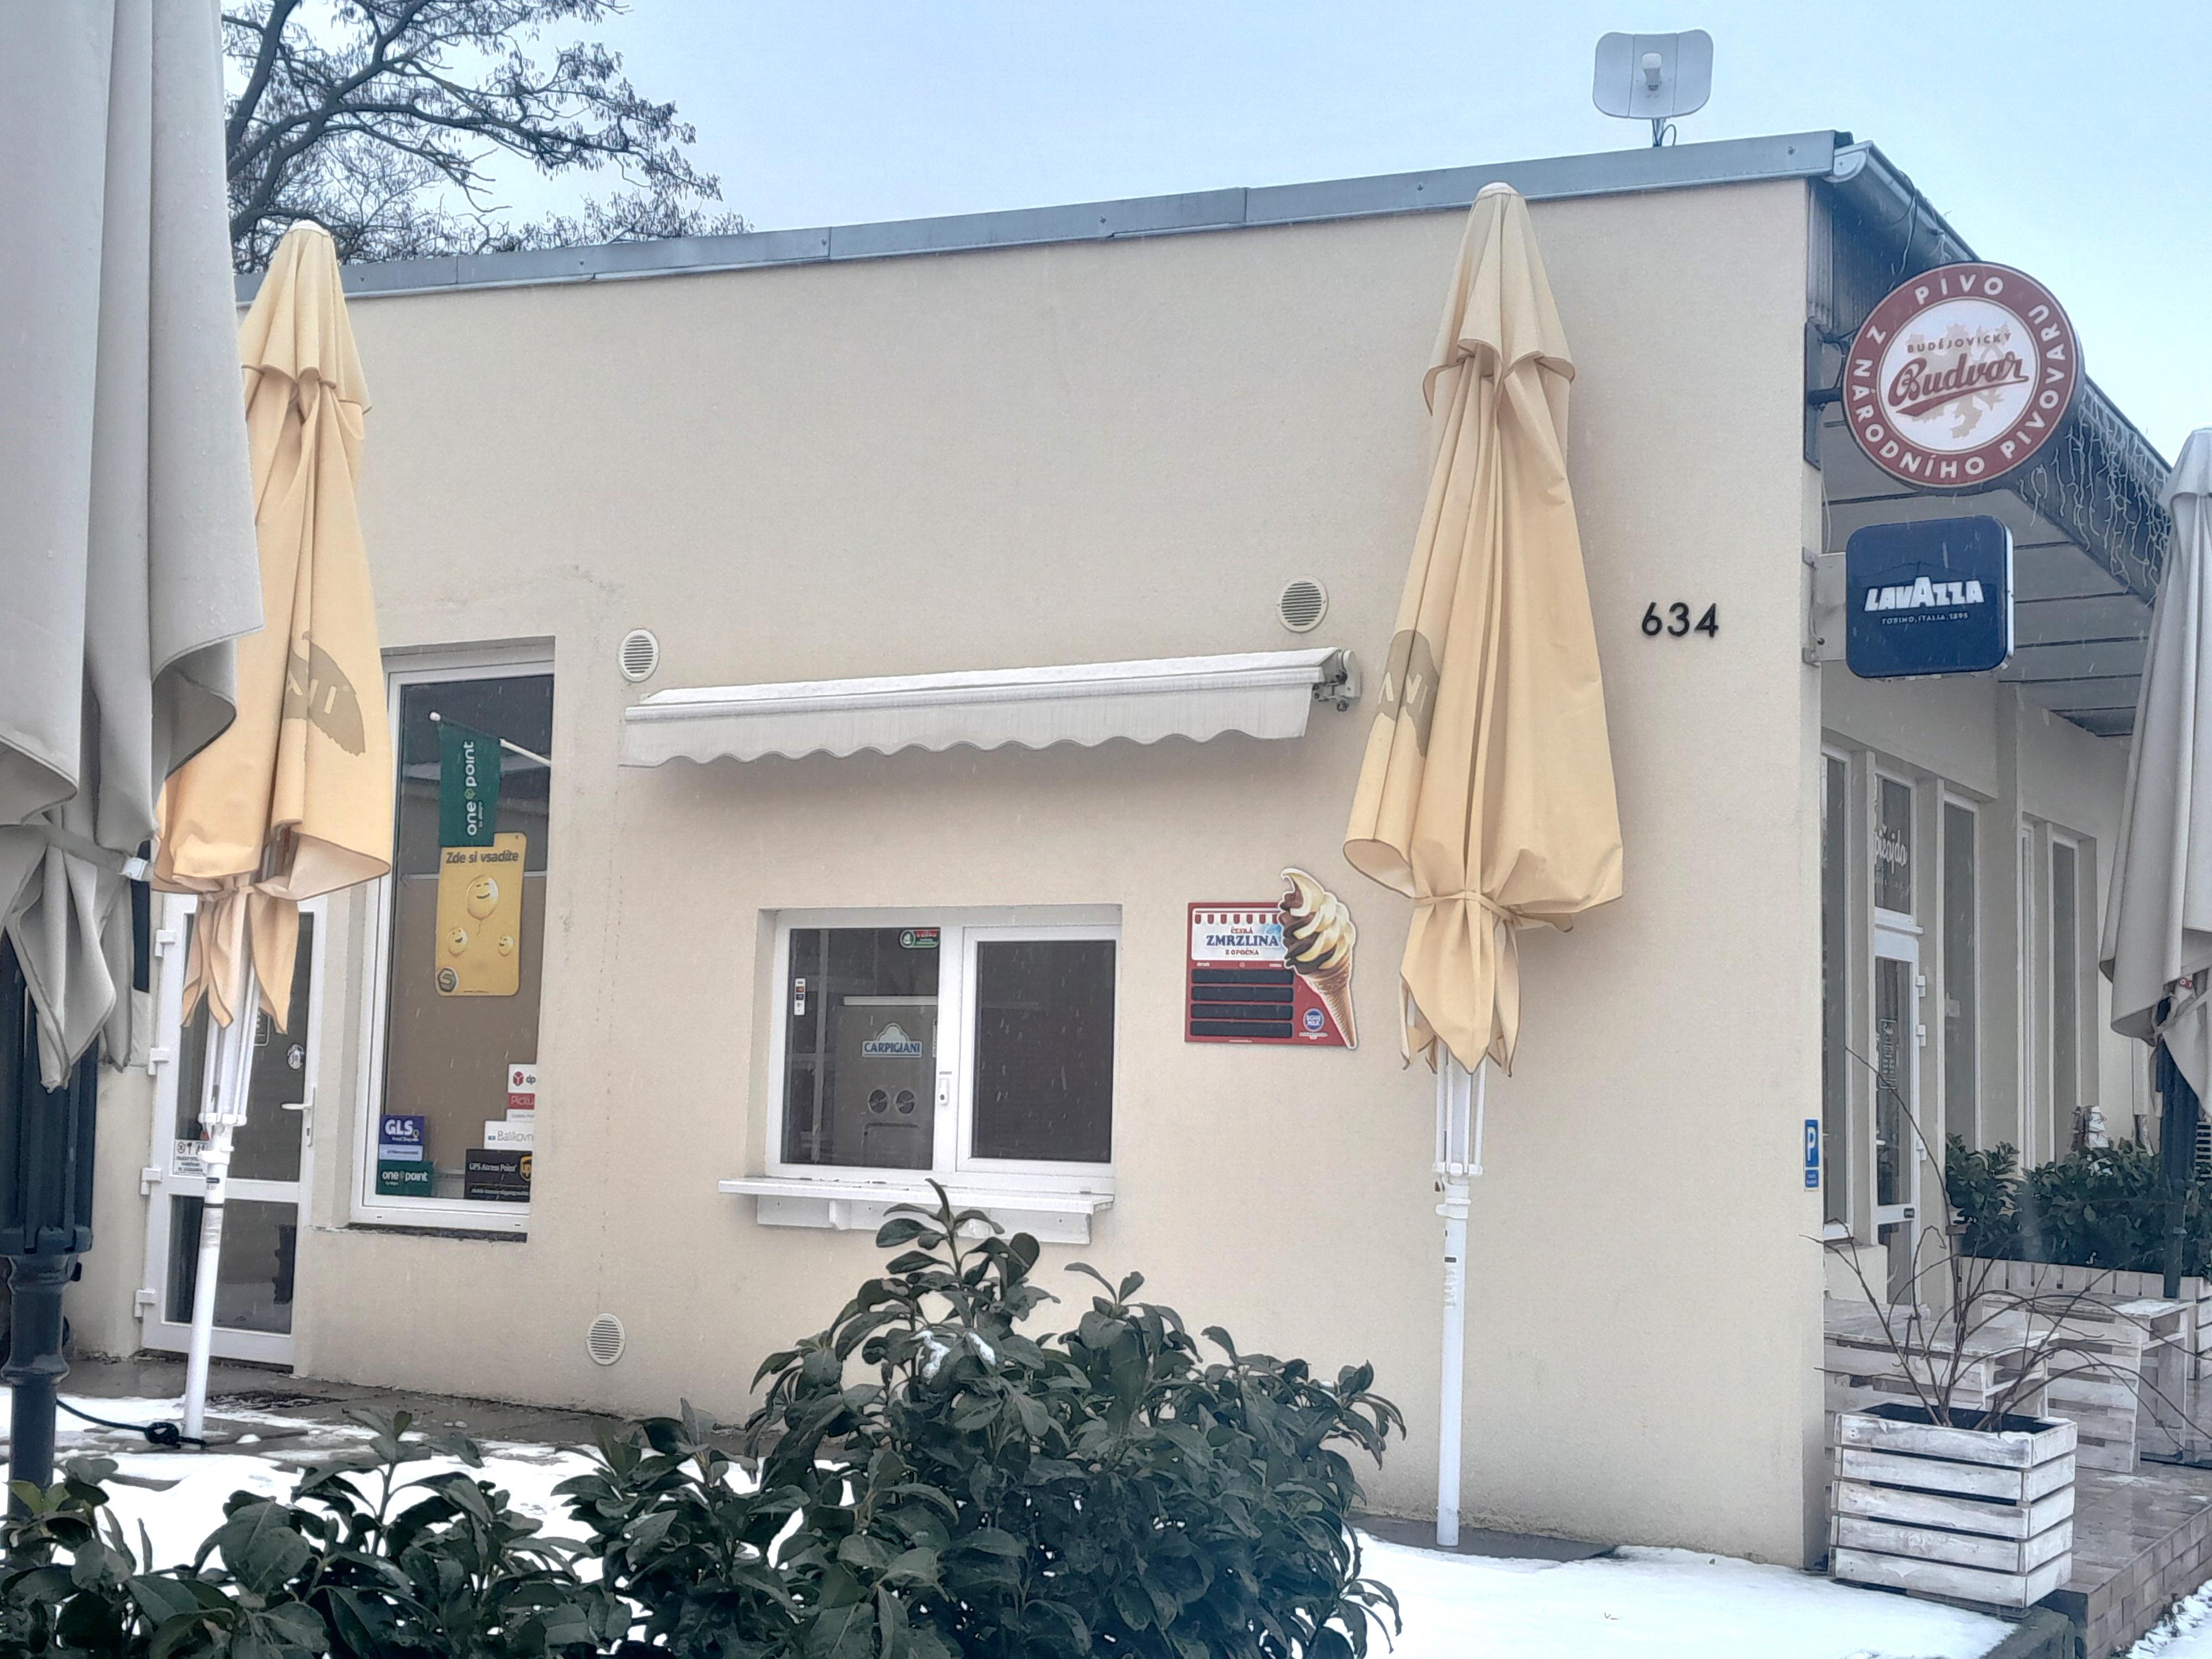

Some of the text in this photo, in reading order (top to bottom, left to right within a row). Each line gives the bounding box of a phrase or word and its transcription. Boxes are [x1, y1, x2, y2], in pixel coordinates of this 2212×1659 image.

[1914, 274, 2004, 304] PIVO
[1853, 304, 2067, 478] Z NÁRODNÍHO PIVOVARU
[1888, 351, 2029, 415] Budvar
[1864, 576, 1985, 612] LAVAZZA
[1641, 602, 1719, 637] 634
[463, 741, 477, 836] one point
[446, 852, 466, 864] Zde
[469, 851, 478, 863] si
[1206, 935, 1279, 946] ZMRZLINA
[864, 1042, 920, 1053] CARPIGIANI
[385, 1119, 414, 1136] GLS
[1807, 1126, 1816, 1161] P
[382, 1171, 429, 1182] one point
